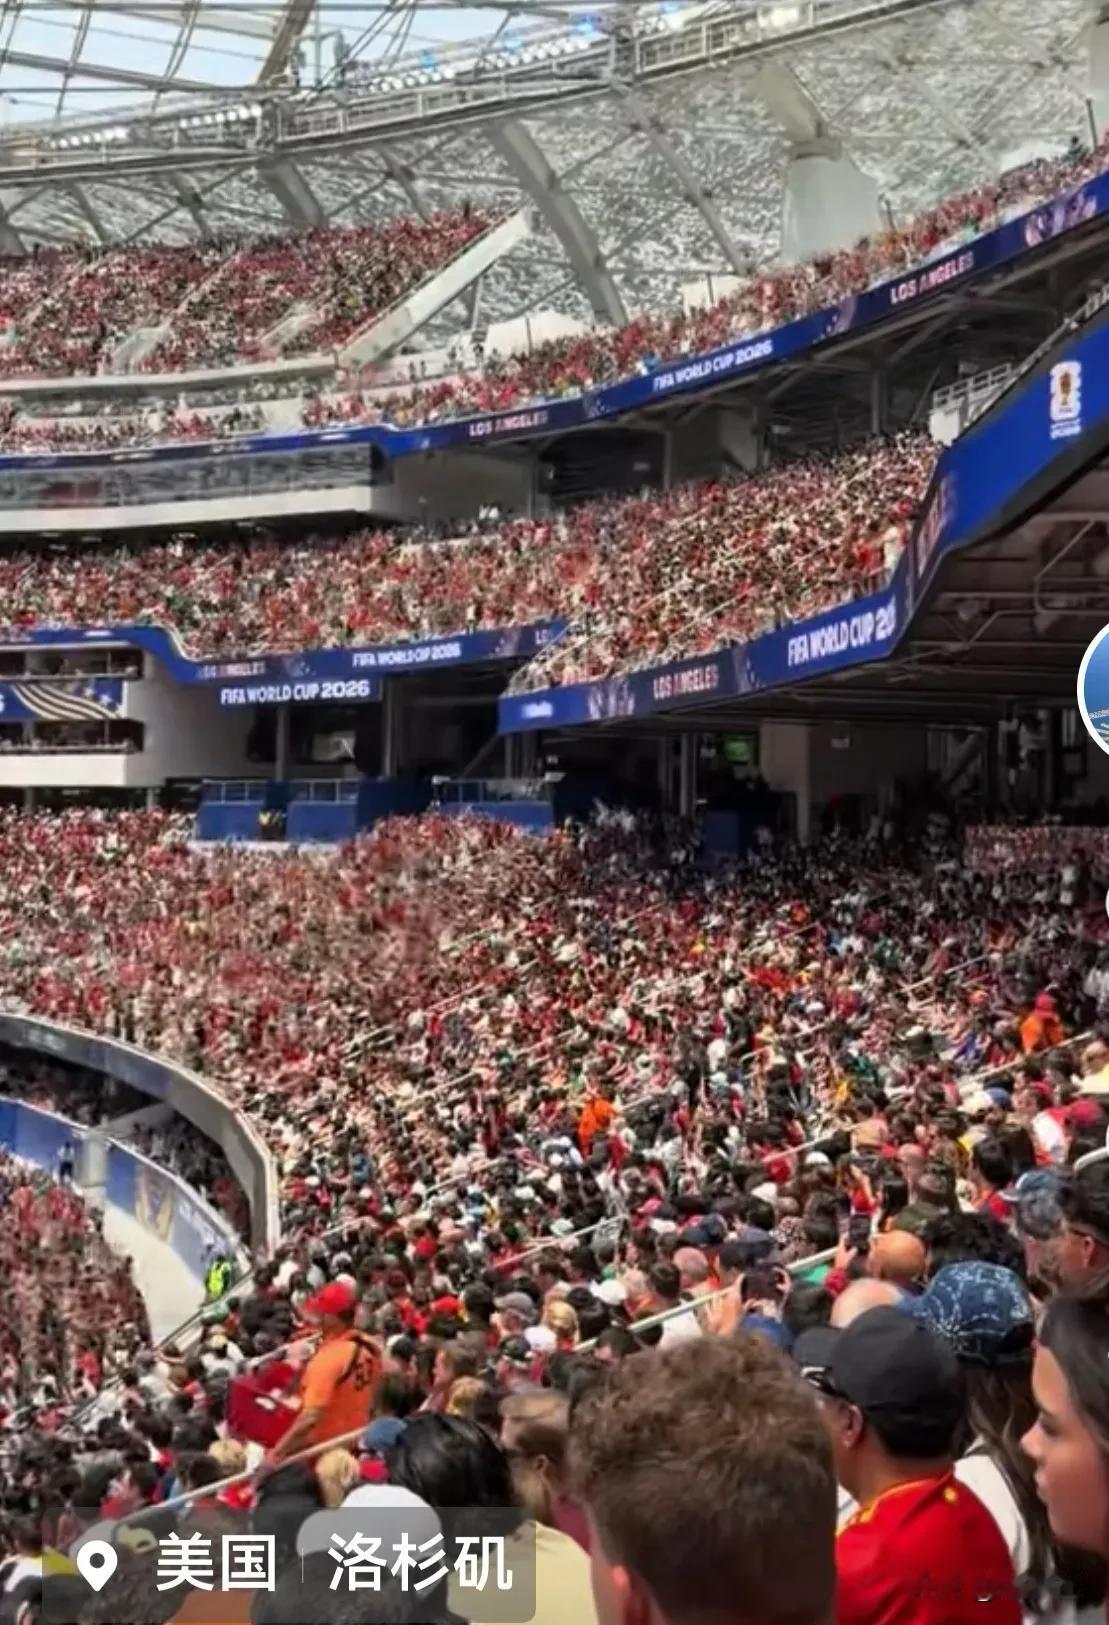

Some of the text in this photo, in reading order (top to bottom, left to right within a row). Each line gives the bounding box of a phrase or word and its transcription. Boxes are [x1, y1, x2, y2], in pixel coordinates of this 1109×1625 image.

[891, 279, 916, 304] LOS
[653, 339, 773, 392] FIFA WORLD CUP 2026
[469, 421, 492, 437] LOS
[788, 634, 809, 666] FIFA
[810, 621, 848, 658] WORLD
[850, 611, 874, 647] CUP
[221, 679, 369, 705] FIFA WORLD CUP 2026
[653, 674, 673, 700] LOS
